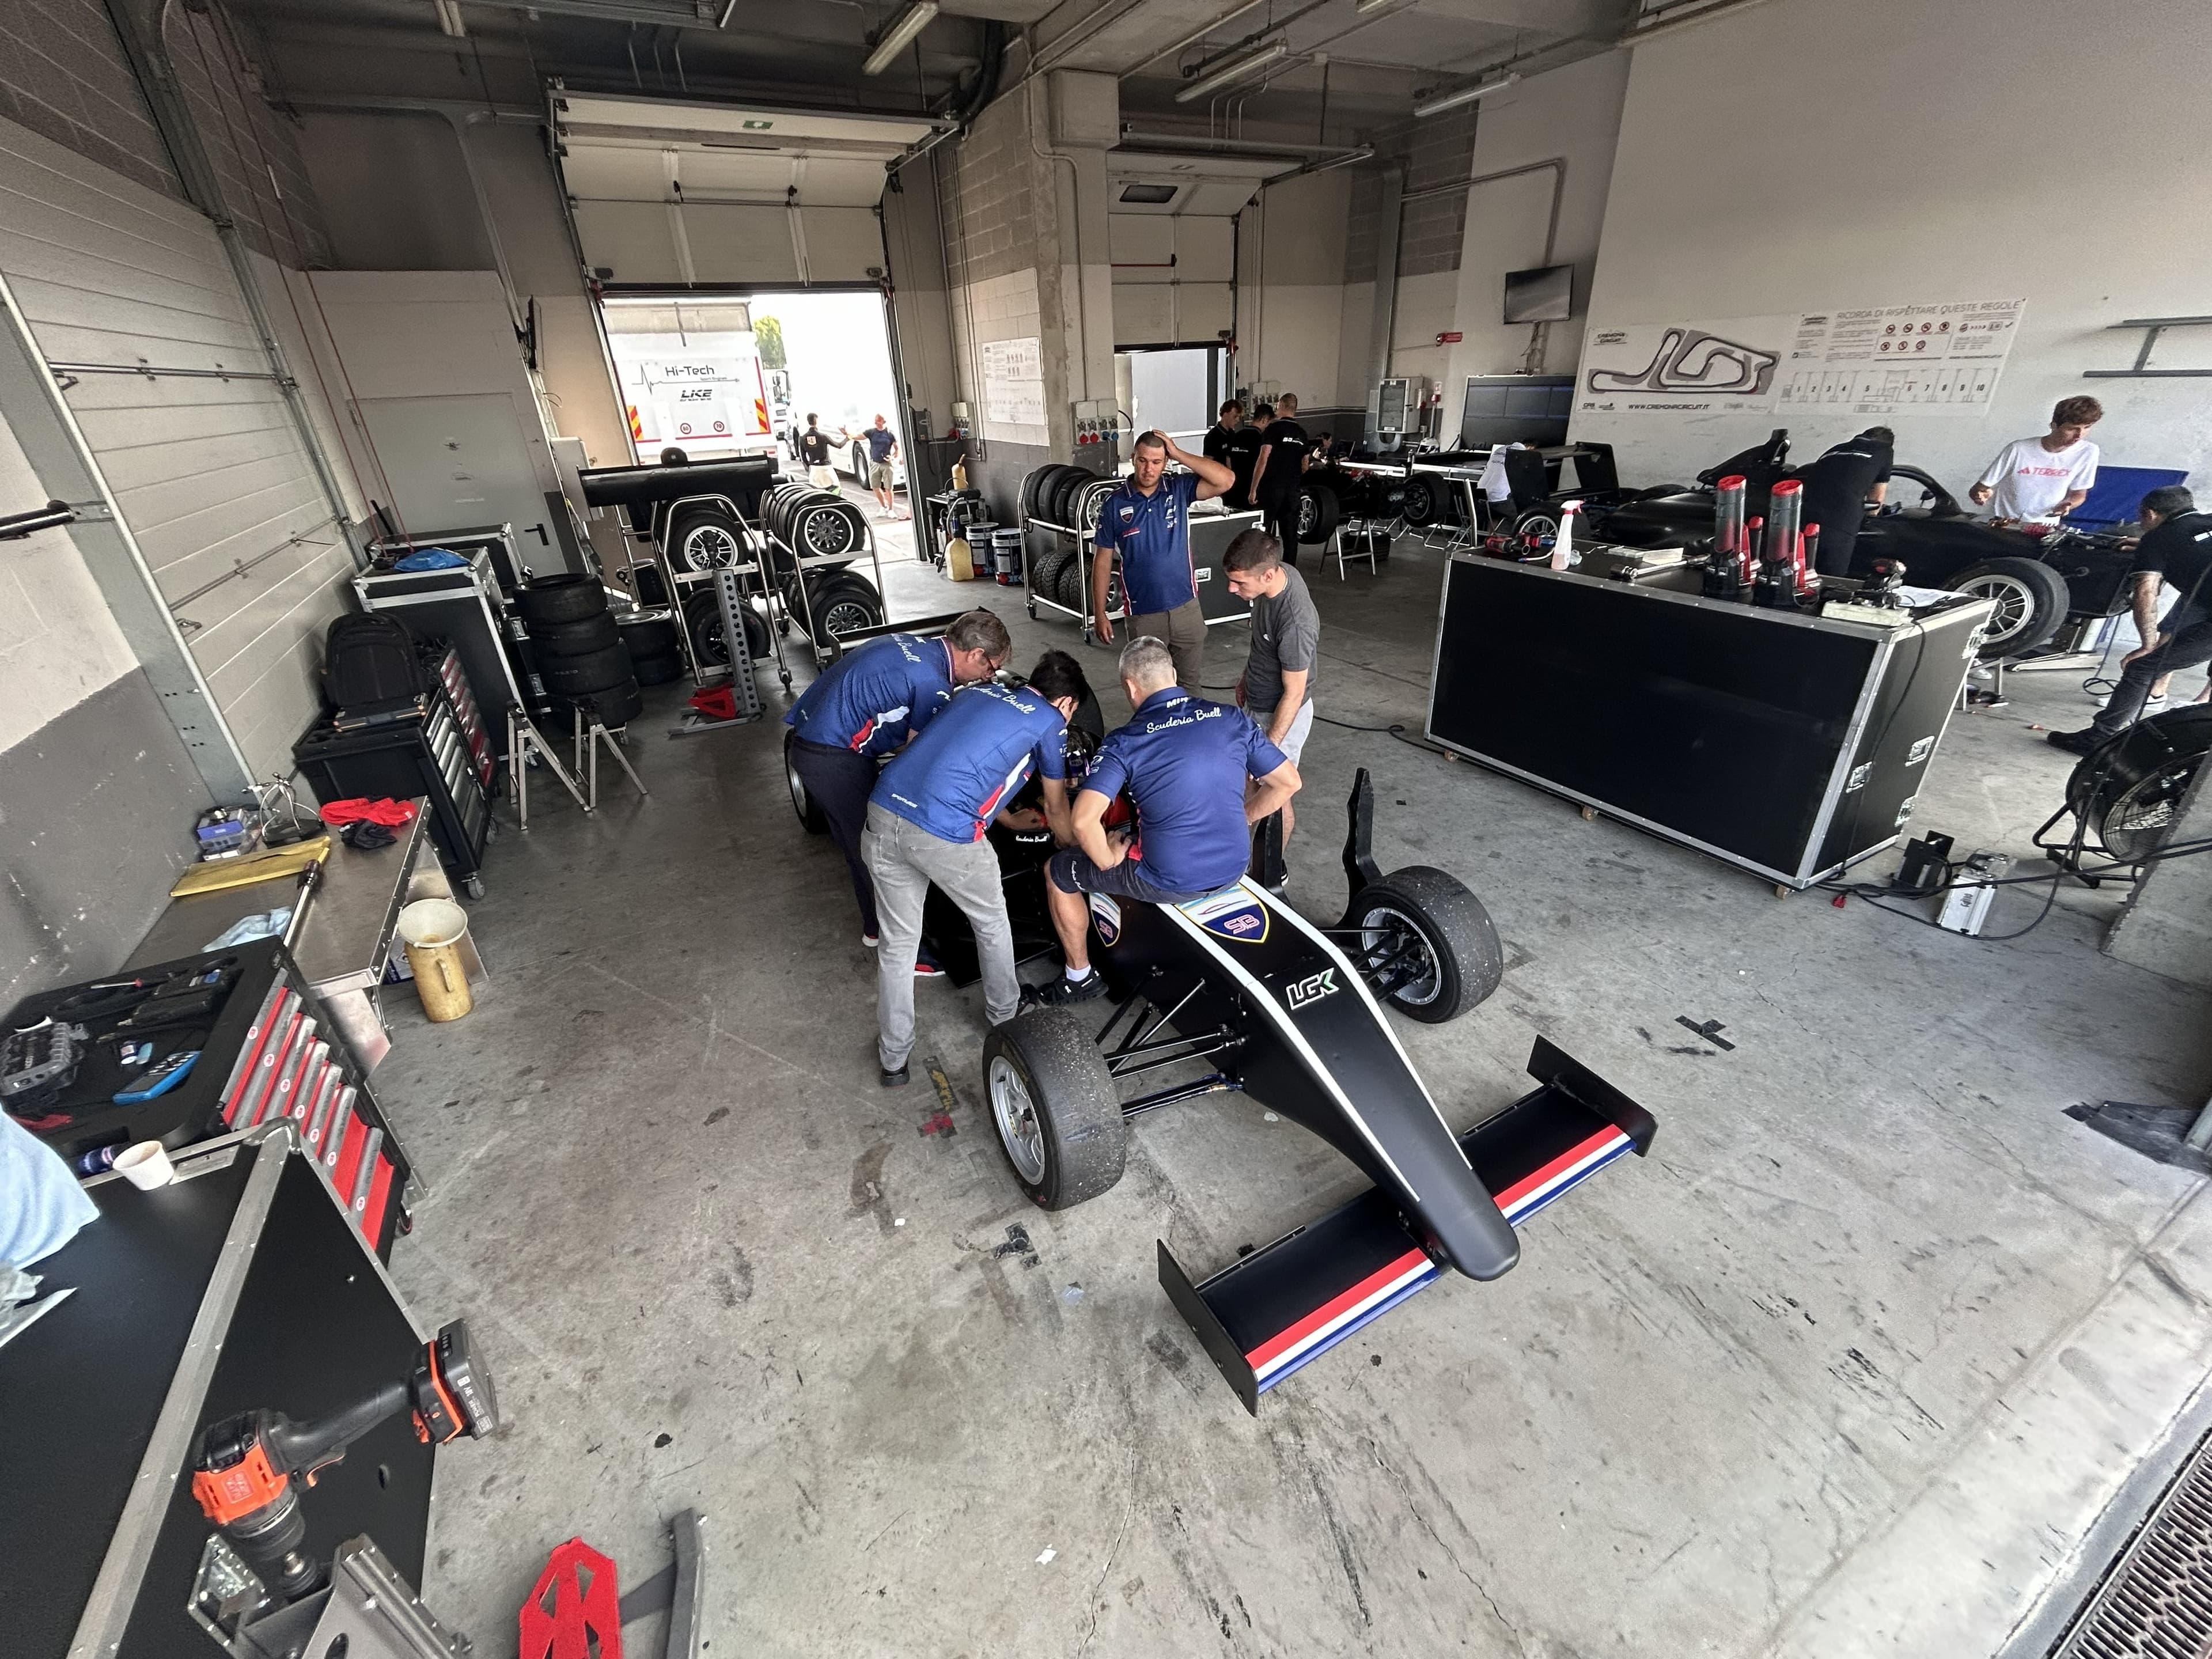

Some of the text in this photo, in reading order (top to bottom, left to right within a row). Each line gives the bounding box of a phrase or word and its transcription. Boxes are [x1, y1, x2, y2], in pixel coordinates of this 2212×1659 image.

[1837, 300, 2021, 319] RICORDA DI RISPETTARE QUESTE REGOLE
[665, 365, 715, 377] Hi-Tech
[1925, 384, 1930, 392] 7
[1960, 384, 1965, 392] 9
[1976, 384, 1986, 392] 10
[1002, 695, 1036, 714] Buell
[1146, 707, 1222, 733] Scuderia Buell
[1286, 967, 1339, 1010] LGK
